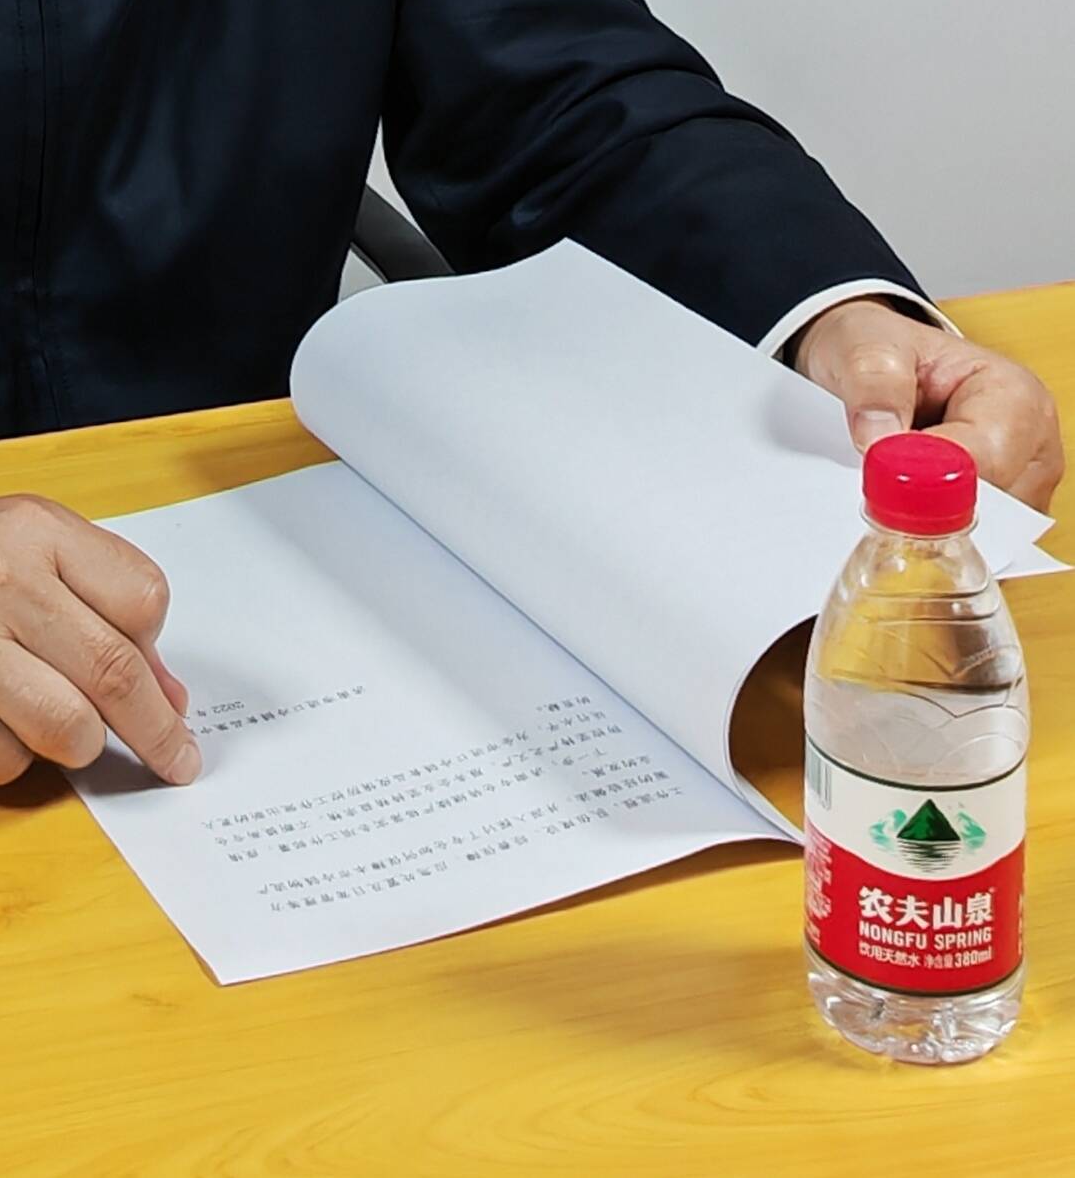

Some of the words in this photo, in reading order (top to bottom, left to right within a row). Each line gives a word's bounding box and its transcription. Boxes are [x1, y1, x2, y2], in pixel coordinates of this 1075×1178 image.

[858, 886, 993, 930] 农夫山泉
[858, 921, 928, 950] NONGFU
[934, 926, 992, 950] SPRING
